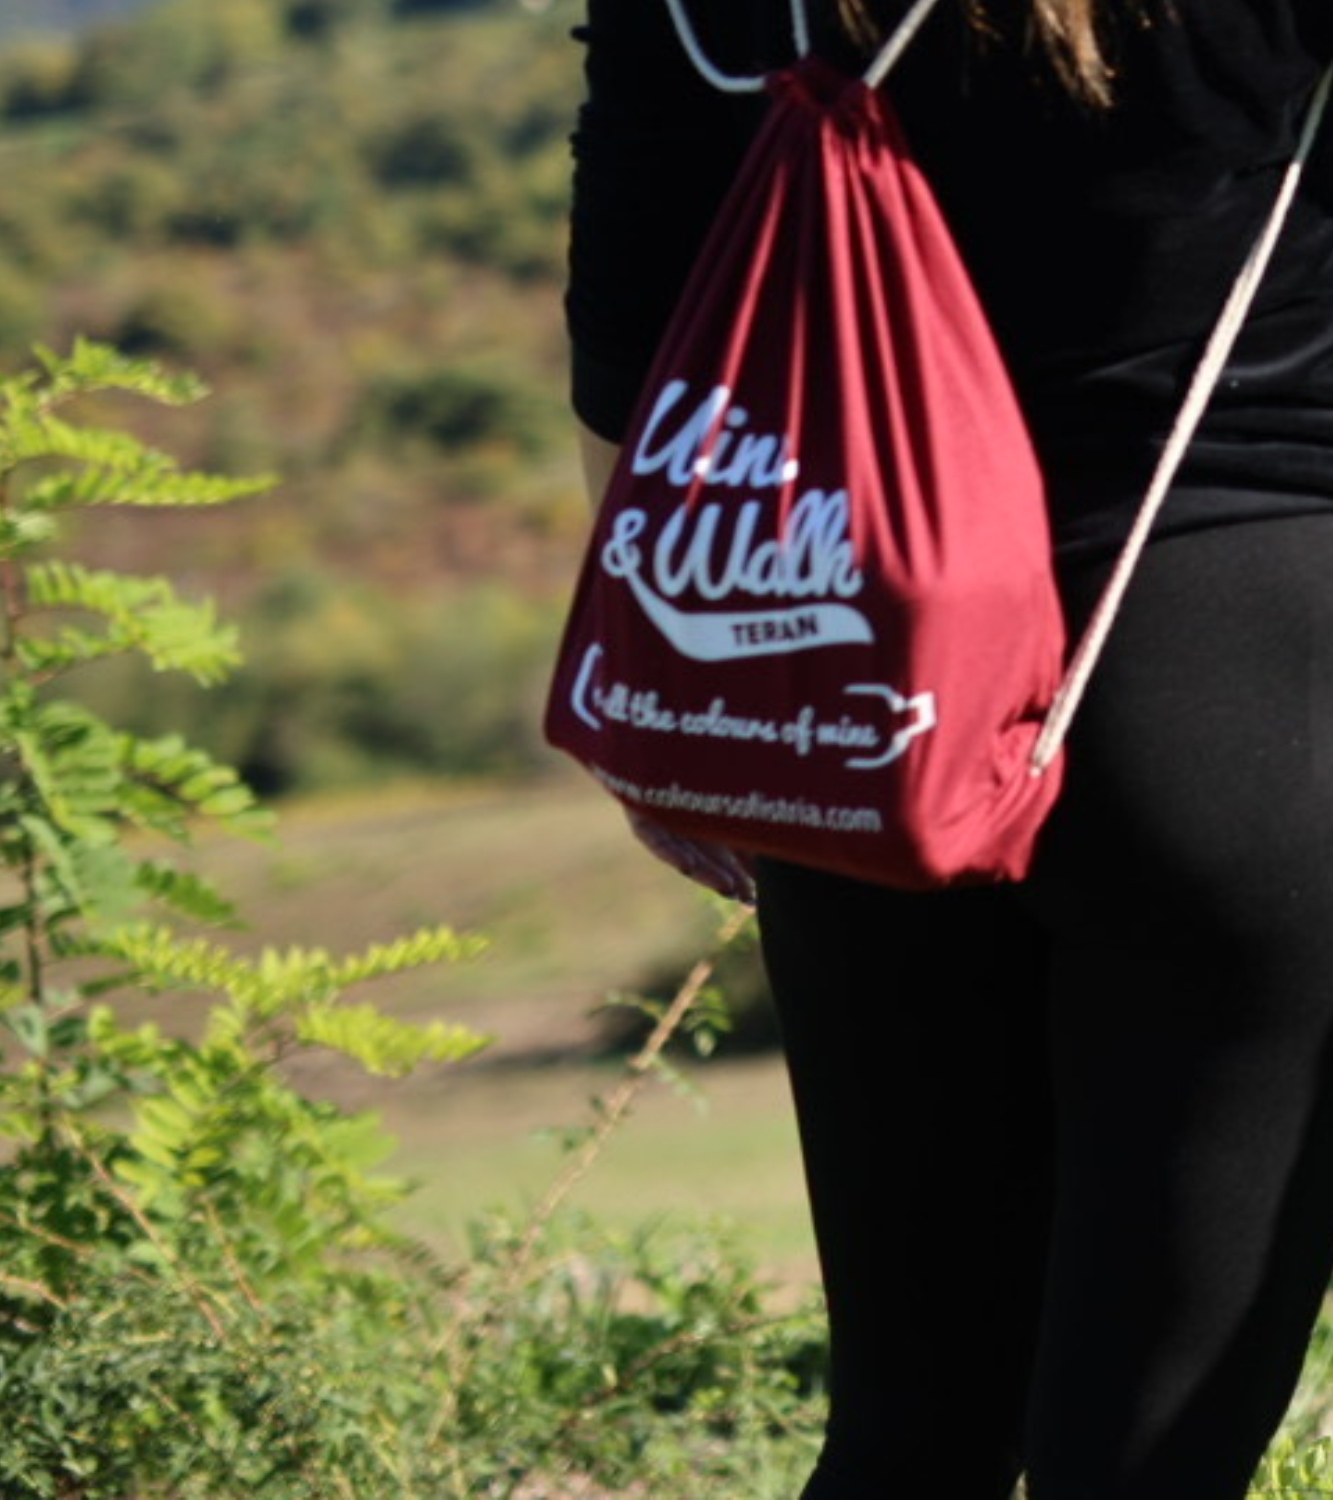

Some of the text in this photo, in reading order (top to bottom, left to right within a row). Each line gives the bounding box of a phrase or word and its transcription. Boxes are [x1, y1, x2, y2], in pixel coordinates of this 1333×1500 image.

[602, 489, 864, 600] & Walk
[731, 613, 820, 647] TERAN
[630, 690, 677, 732] the
[679, 698, 778, 742] colours
[780, 705, 815, 756] of
